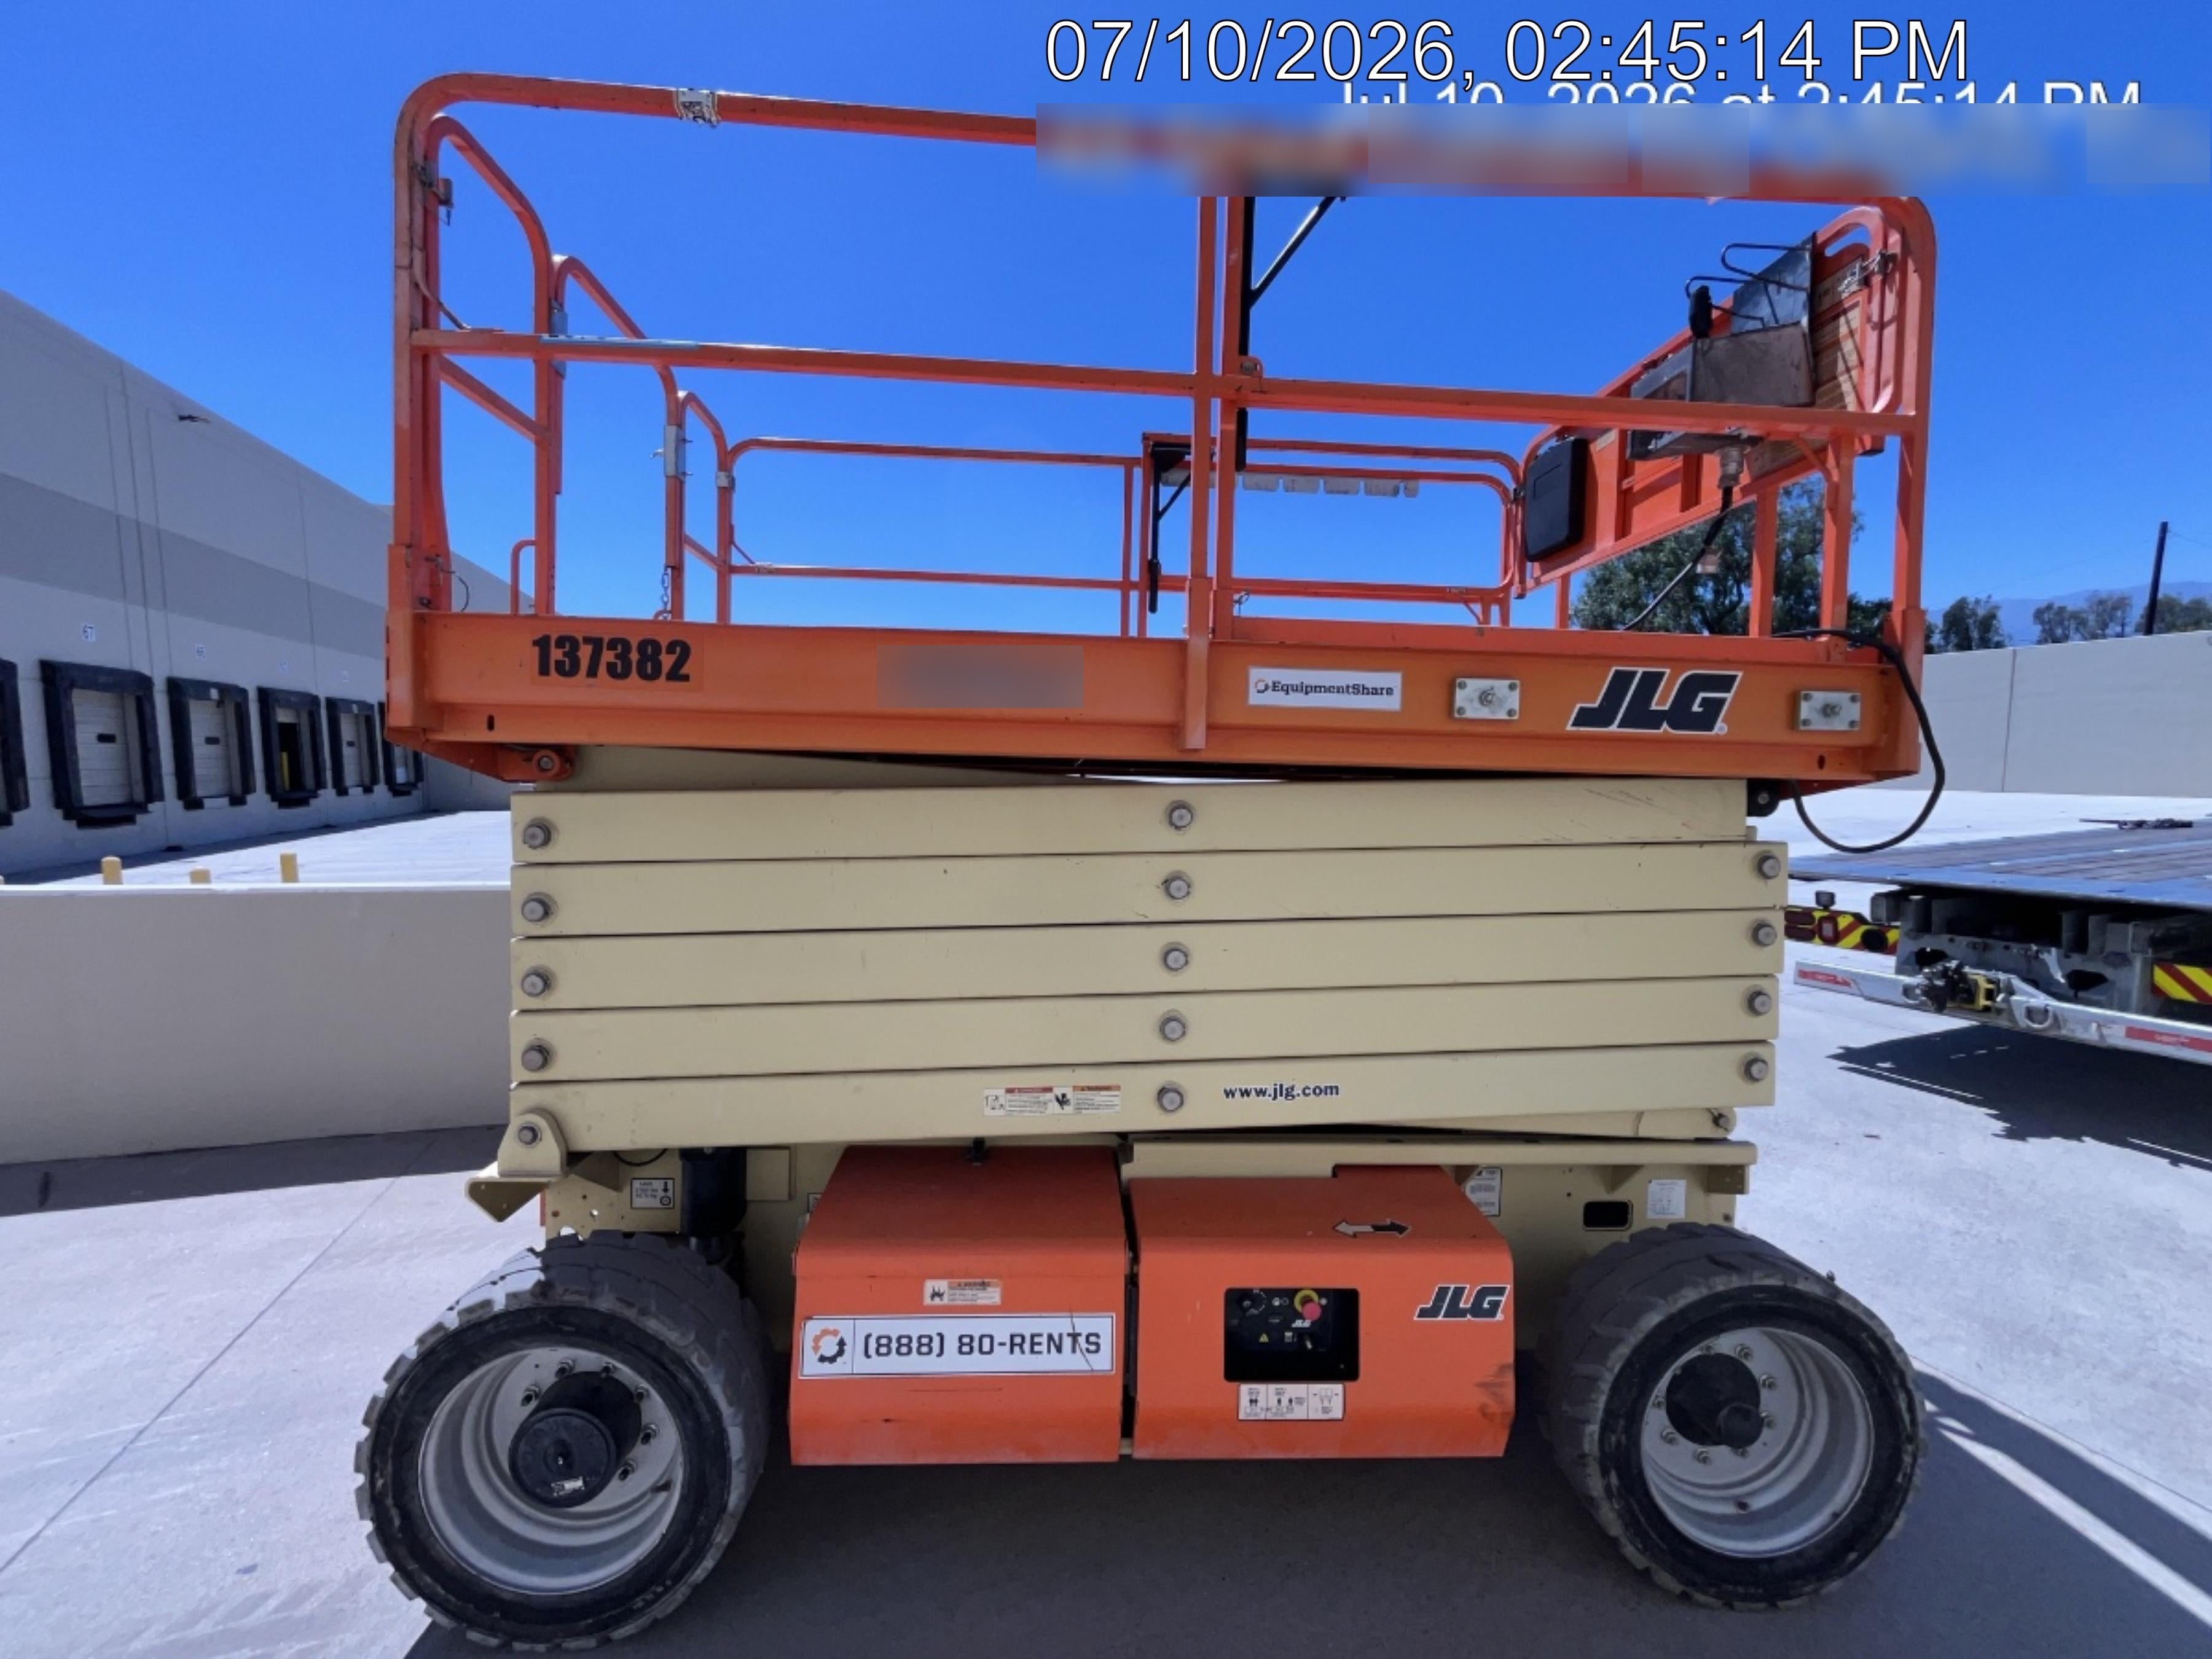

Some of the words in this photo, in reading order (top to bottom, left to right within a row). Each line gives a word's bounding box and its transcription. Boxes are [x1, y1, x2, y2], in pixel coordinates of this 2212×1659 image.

[532, 634, 691, 682] 137382
[1271, 681, 1394, 696] EquipmentShare
[1566, 667, 1743, 734] JLG
[1223, 1083, 1339, 1101] www.jlg.com
[1414, 1284, 1510, 1321] JLG
[864, 1333, 945, 1358] (888)
[958, 1332, 1101, 1355] 80-RENTS
